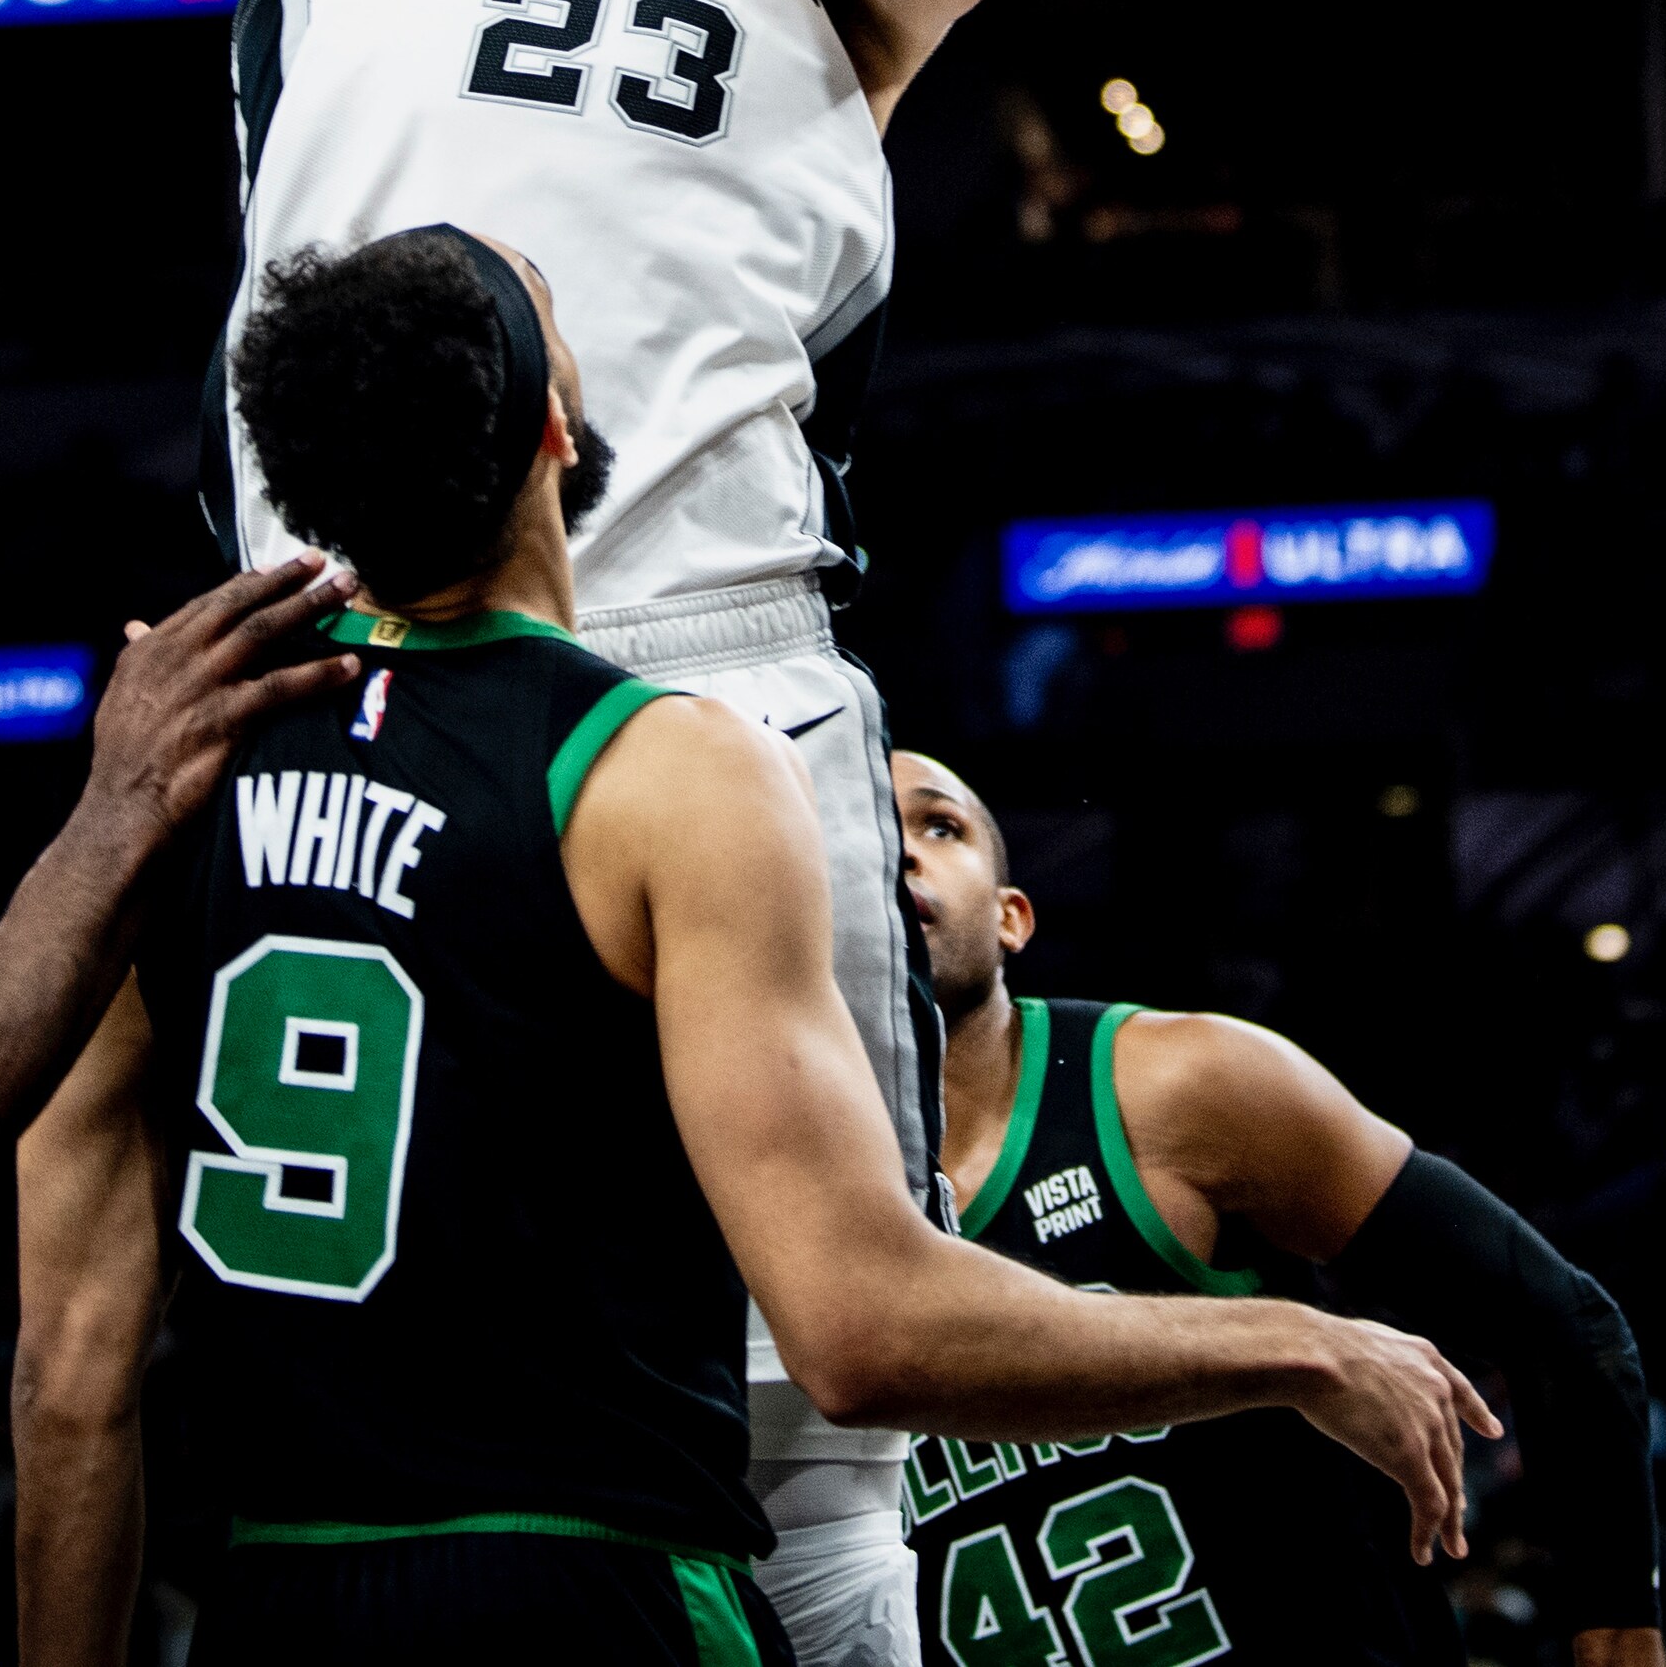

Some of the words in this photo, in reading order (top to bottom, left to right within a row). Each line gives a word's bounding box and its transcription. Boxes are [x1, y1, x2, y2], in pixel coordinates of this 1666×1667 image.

[236, 770, 447, 920] WHITE
[178, 934, 425, 1303] 9
[1024, 1165, 1099, 1218] VISTA
[1034, 1195, 1103, 1244] PRINT
[940, 1475, 1232, 1667] 42
